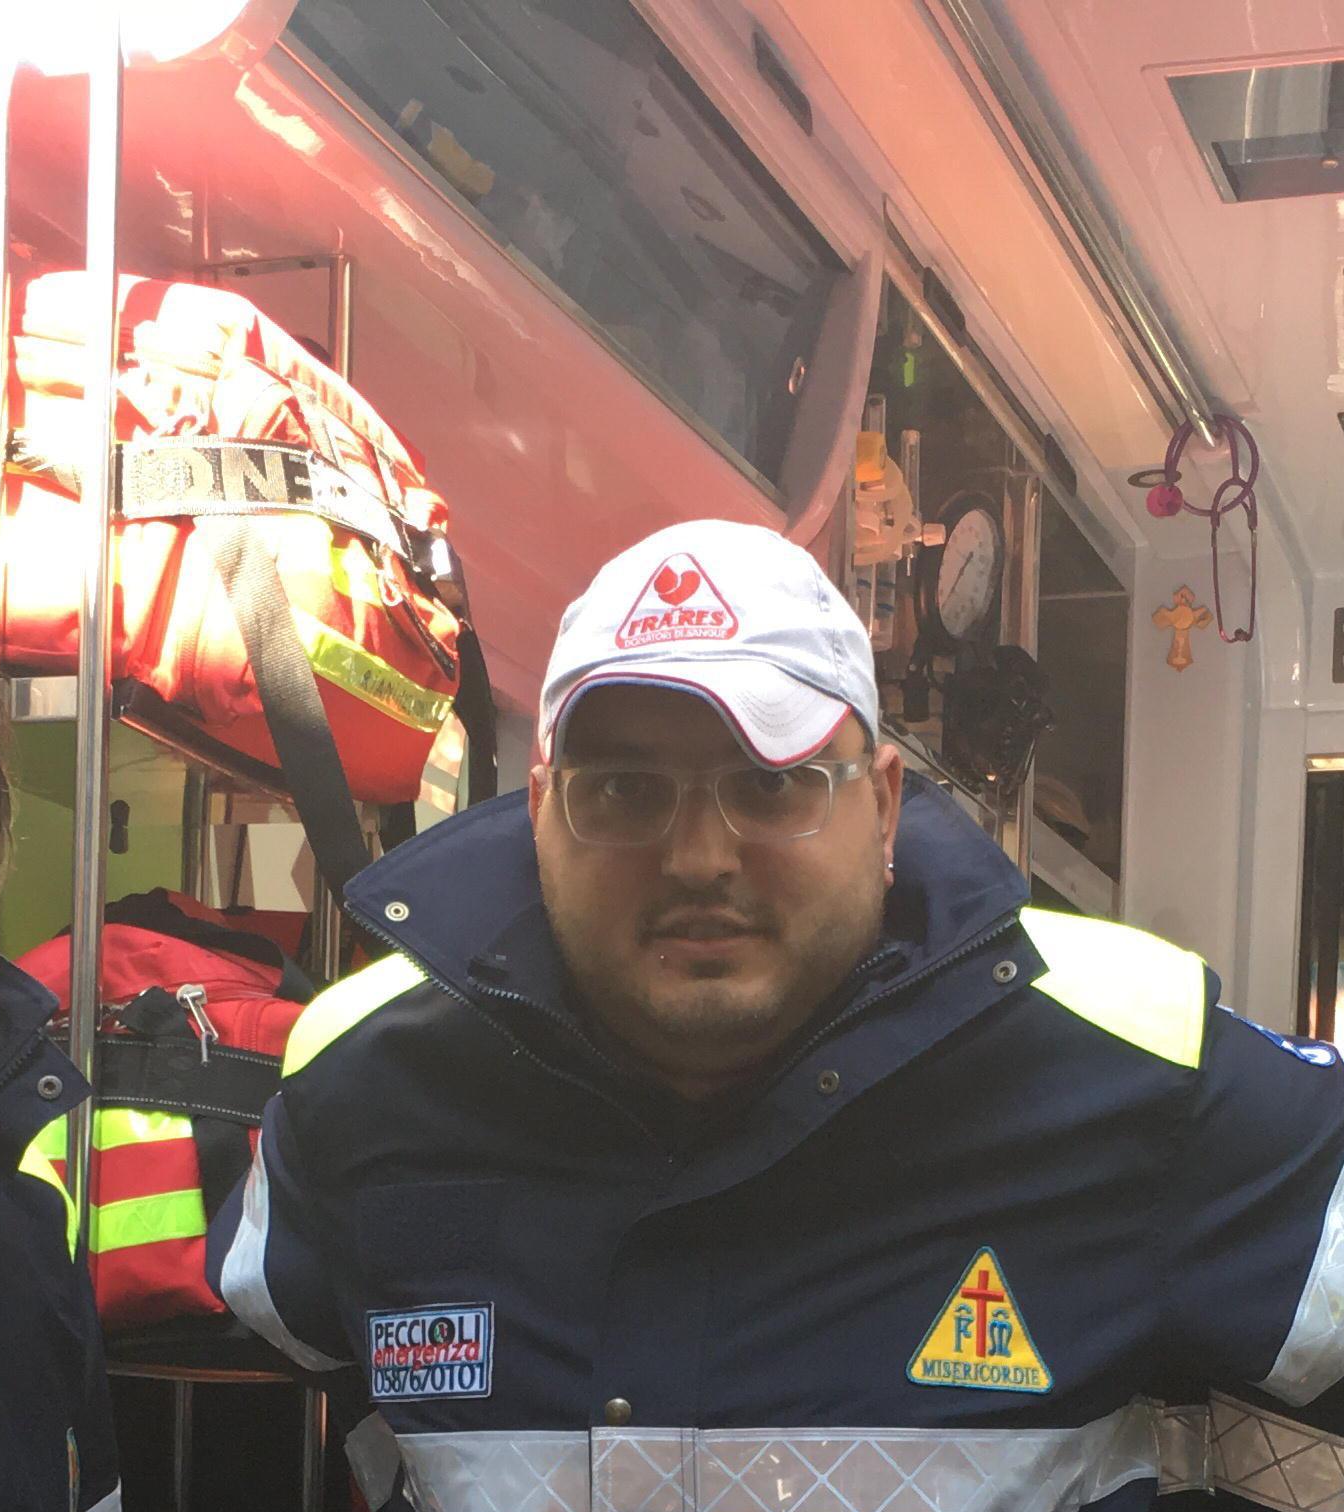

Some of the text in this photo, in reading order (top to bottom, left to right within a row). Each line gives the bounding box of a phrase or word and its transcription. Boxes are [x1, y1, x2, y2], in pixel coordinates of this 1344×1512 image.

[374, 1315, 480, 1350] PECCIOLI
[373, 1342, 480, 1371] emergenza
[374, 1362, 484, 1393] 0587670101
[921, 1359, 1040, 1385] MISERICORDIE
